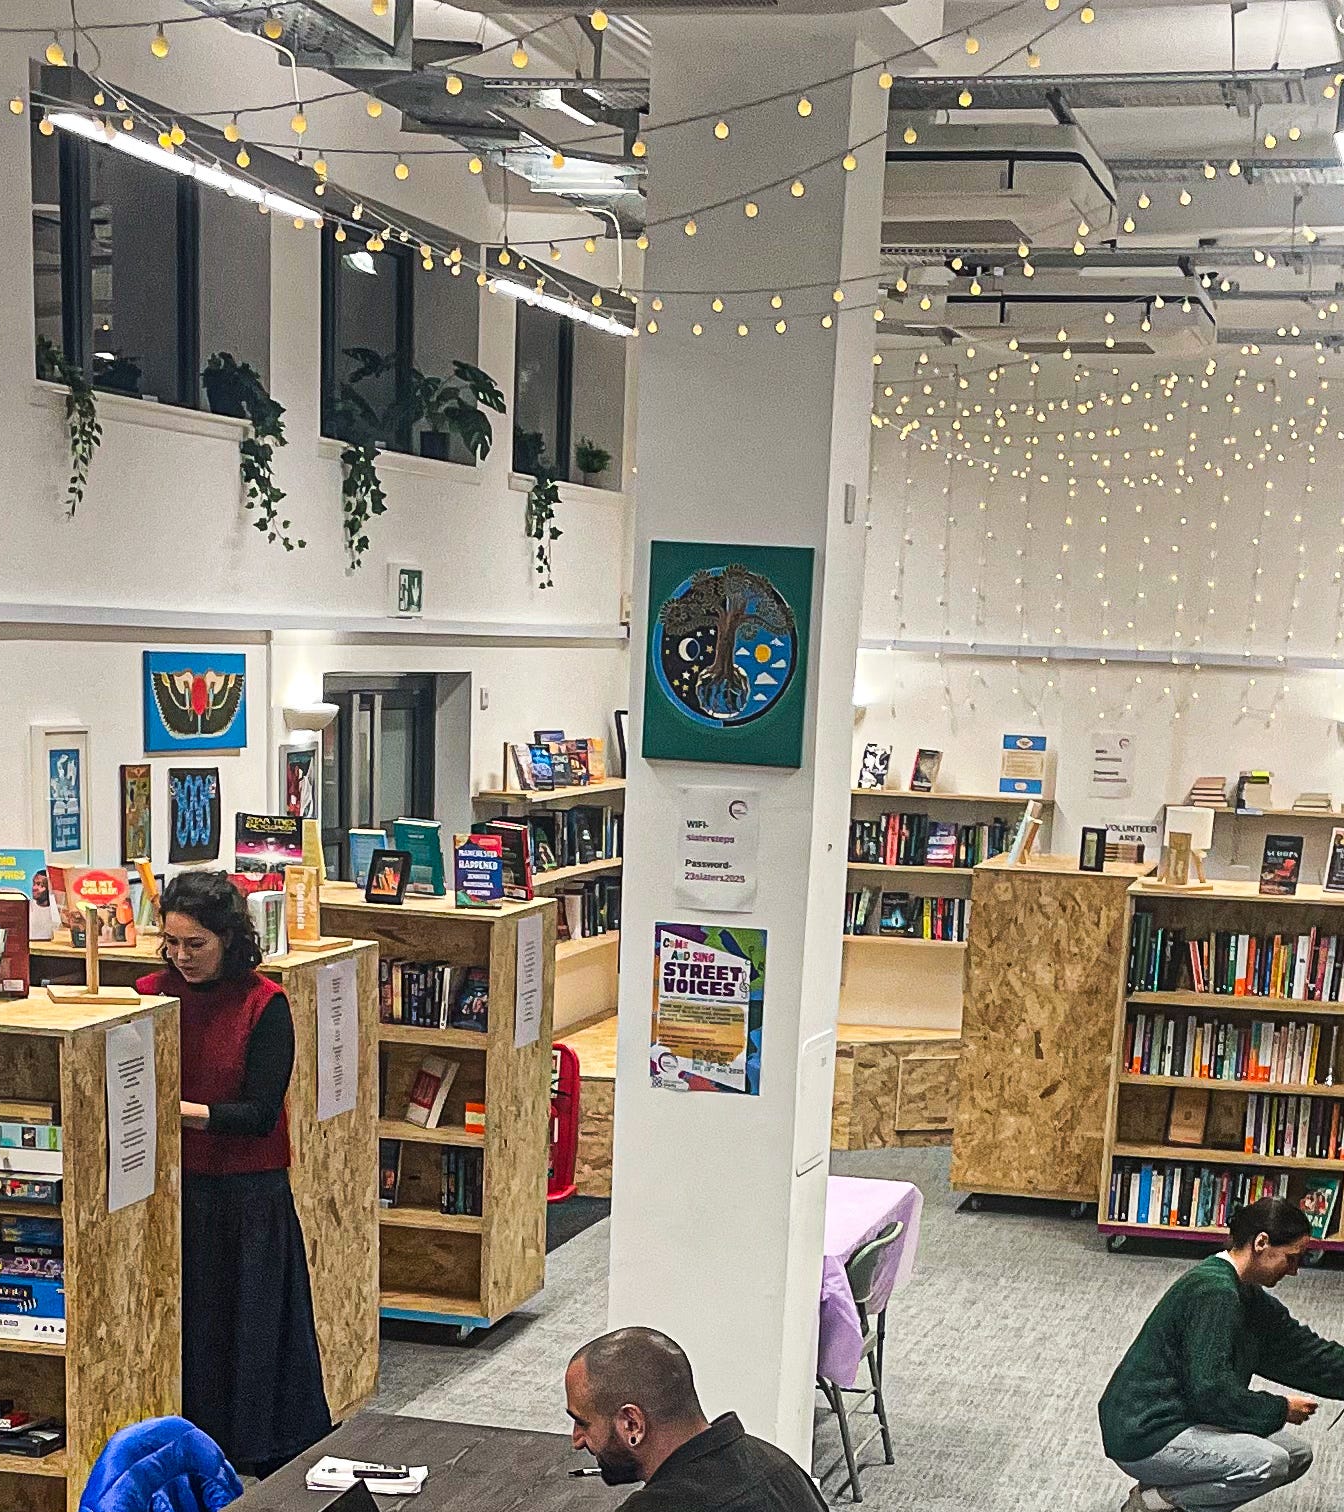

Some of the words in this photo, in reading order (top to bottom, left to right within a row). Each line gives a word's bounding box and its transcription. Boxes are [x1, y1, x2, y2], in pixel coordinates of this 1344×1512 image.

[1105, 824, 1157, 834] VOLUNTEER
[662, 937, 688, 949] COME
[671, 950, 690, 961] AND
[692, 951, 715, 963] SING
[664, 962, 742, 982] STREET
[663, 977, 736, 997] VOICES
